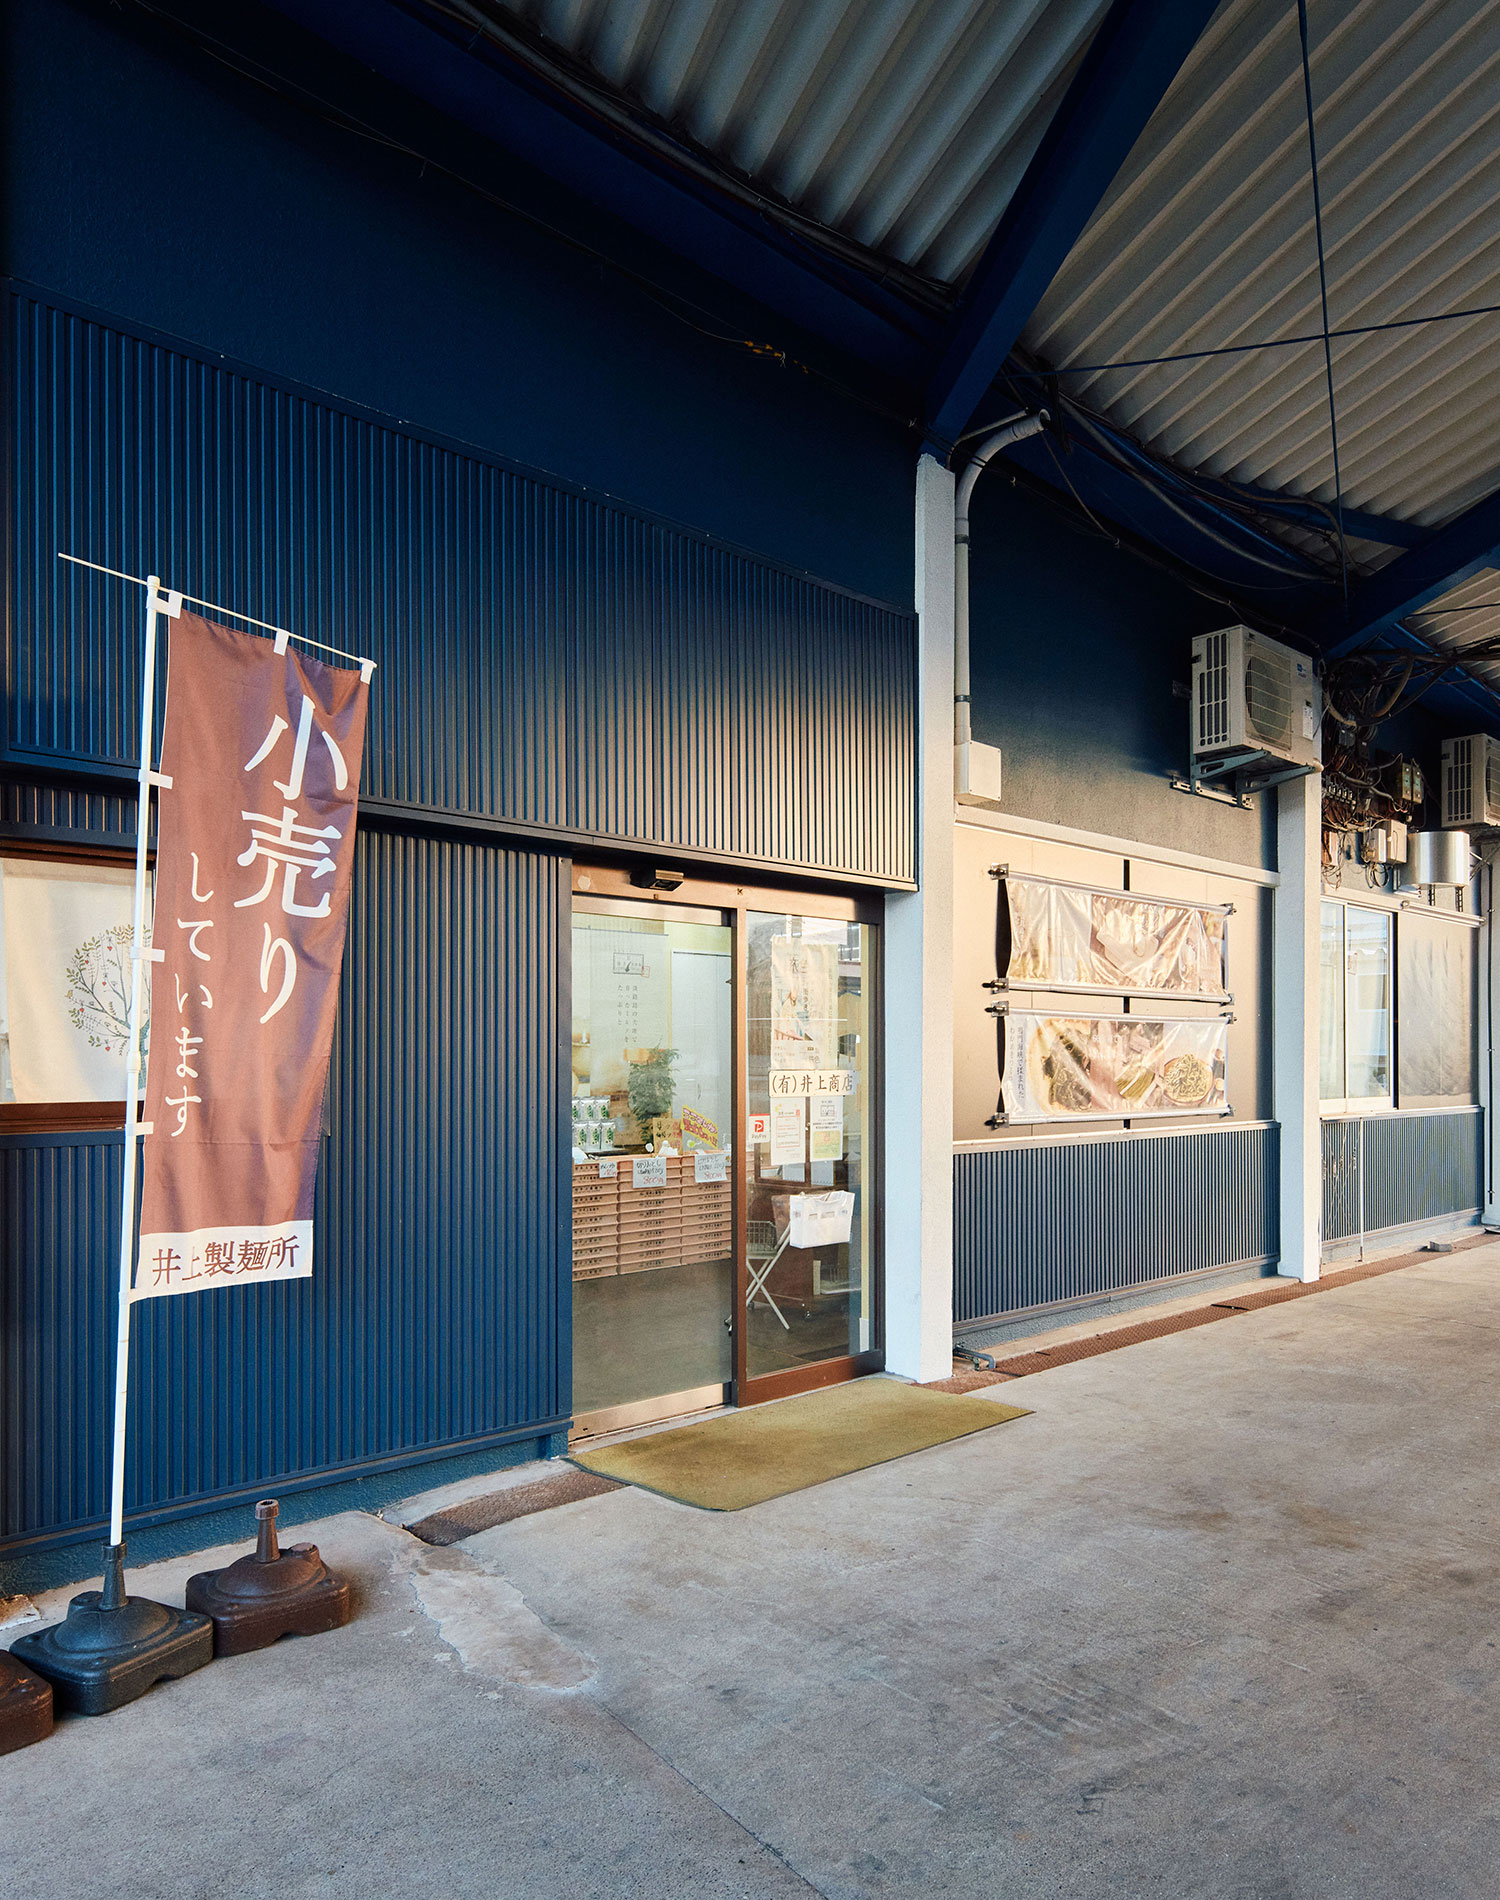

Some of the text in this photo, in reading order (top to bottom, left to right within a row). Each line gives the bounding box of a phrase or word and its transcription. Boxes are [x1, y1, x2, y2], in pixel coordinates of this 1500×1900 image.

[164, 852, 214, 1137] しています
[234, 694, 348, 1024] 小売り
[152, 1234, 300, 1287] 井上製麺所
